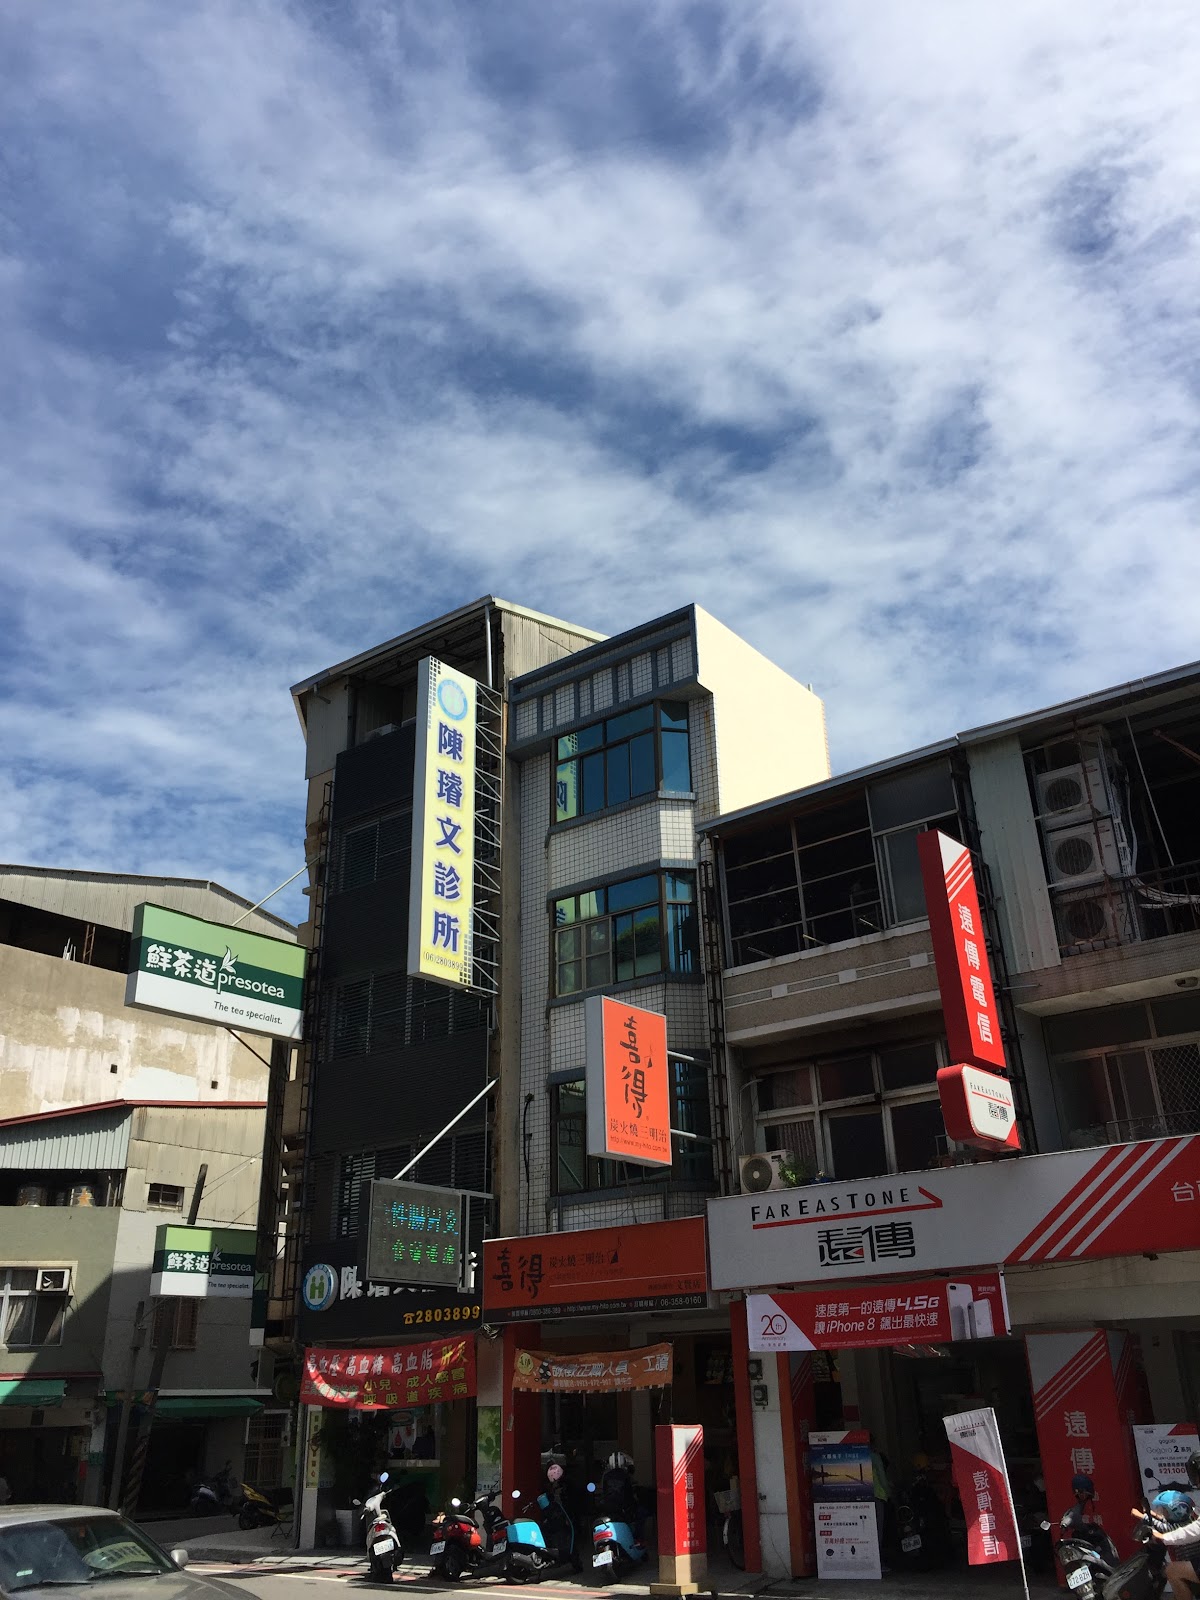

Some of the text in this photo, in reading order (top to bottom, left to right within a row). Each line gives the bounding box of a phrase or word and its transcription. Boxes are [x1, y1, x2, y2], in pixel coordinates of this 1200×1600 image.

[432, 721, 464, 953] 陳璿文診所
[145, 943, 216, 985] 鮮茶道
[958, 902, 993, 1045] 遠傳電信
[216, 972, 285, 999] presotea
[214, 1000, 283, 1025] The tea specialist.
[610, 1118, 667, 1143] 炭火燒三明治
[1170, 1180, 1200, 1202] 台
[817, 1221, 916, 1267] 遠傳
[167, 1252, 209, 1272] 鮮茶道
[209, 1260, 251, 1277] presotea
[416, 1305, 480, 1324] 2803899
[867, 1319, 875, 1331] 8
[391, 1348, 434, 1375] 高血脂
[363, 1382, 468, 1406] 呼吸道疾病
[1063, 1410, 1095, 1476] 遠傳
[1173, 1445, 1179, 1453] 2
